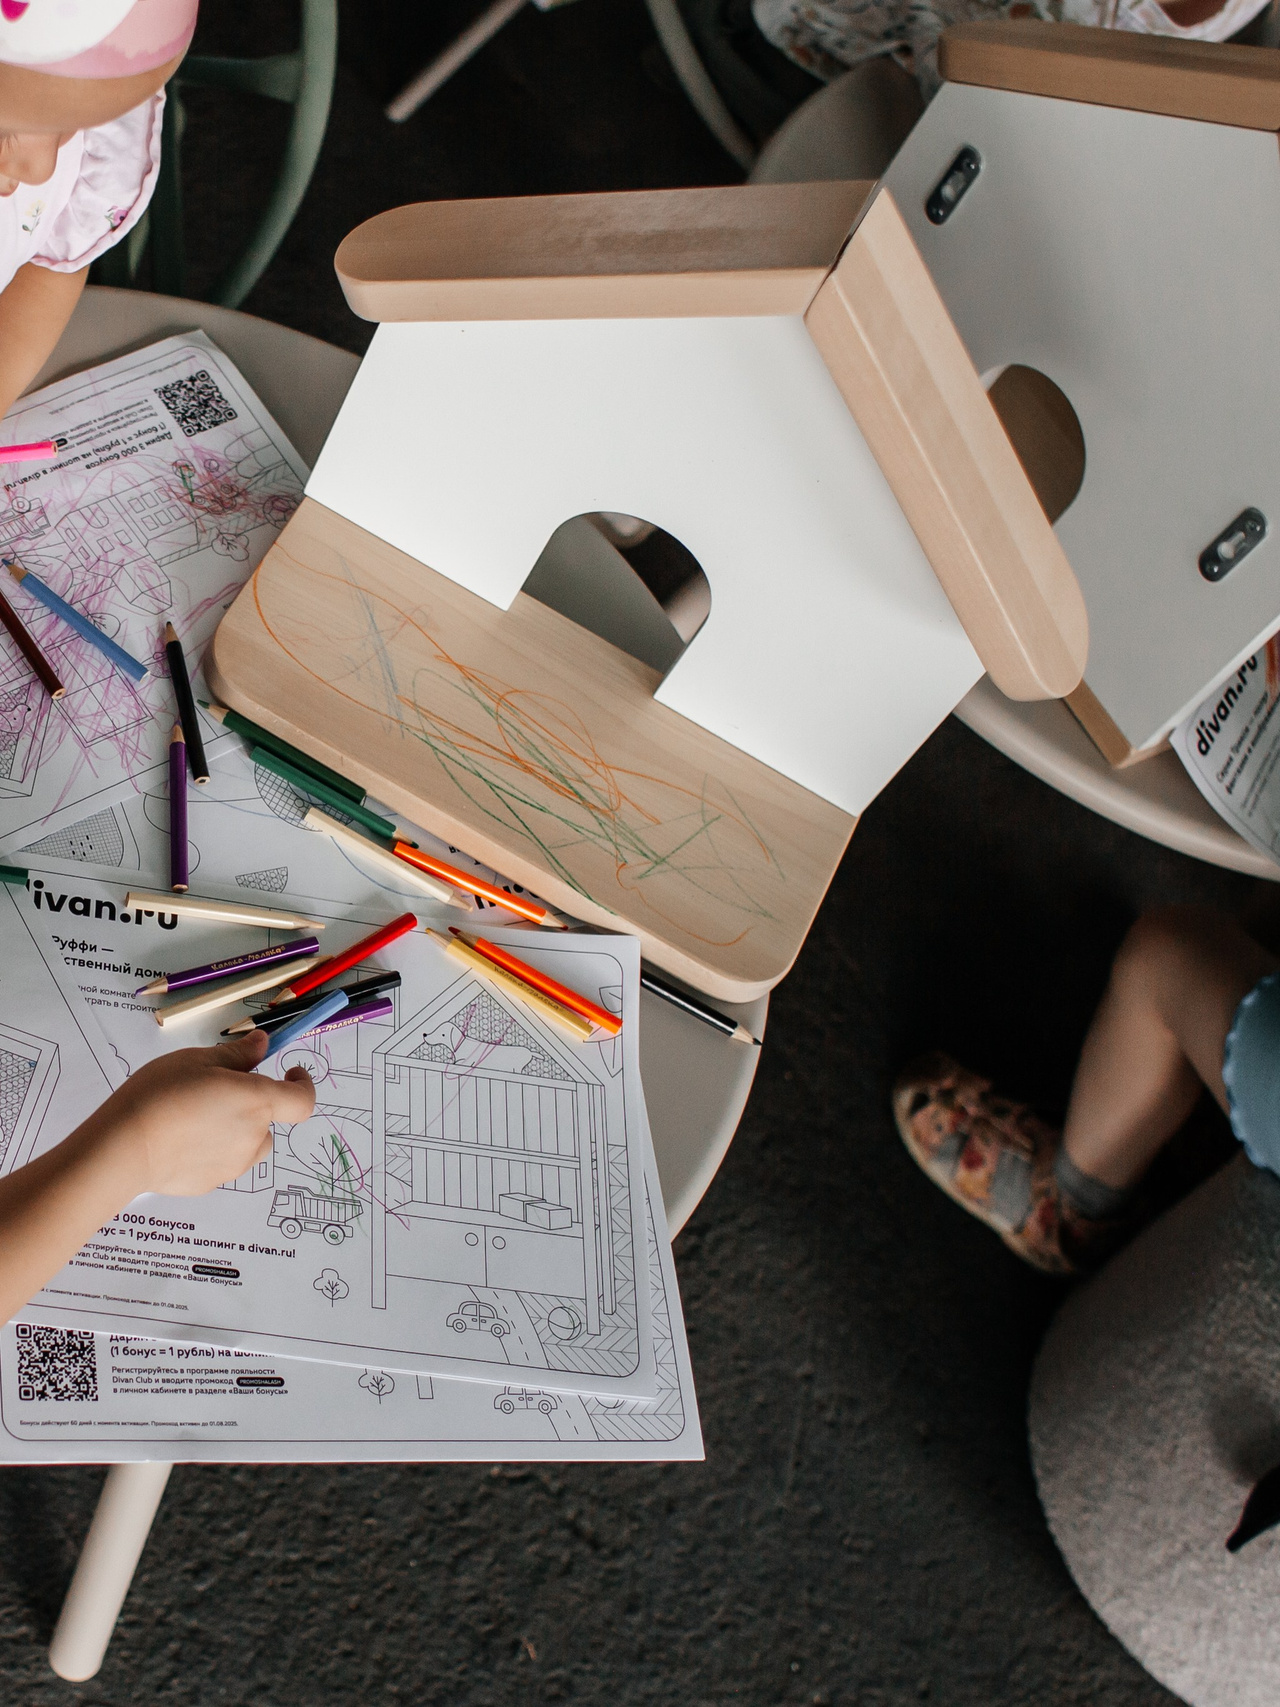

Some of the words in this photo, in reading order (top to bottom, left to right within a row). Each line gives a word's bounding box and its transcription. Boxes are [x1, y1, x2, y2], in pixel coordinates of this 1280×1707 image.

[120, 437, 127, 445] 1
[132, 423, 158, 441] бонус
[80, 450, 91, 459] на
[91, 438, 121, 457] рубль)
[120, 444, 138, 457] 000
[137, 442, 144, 450] 3
[48, 454, 80, 473] шопинг
[84, 450, 120, 472] бонусов
[3, 470, 41, 492] divan.ru!
[1197, 654, 1258, 757] divan.ru
[25, 879, 179, 930] ivan.ru
[59, 952, 131, 974] ственный
[77, 983, 97, 994] ной
[99, 987, 136, 999] комнате
[83, 996, 112, 1007] грать
[120, 1002, 160, 1015] строите
[122, 1213, 146, 1225] 000
[147, 1216, 195, 1232] бонусов
[96, 1225, 116, 1238] нус
[128, 1228, 133, 1237] 1
[136, 1229, 174, 1244] рубль)
[177, 1235, 190, 1244] на
[193, 1237, 236, 1250] шопинг
[247, 1243, 296, 1258] divan.ru!
[75, 1250, 90, 1258] van
[92, 1251, 109, 1261] Club
[117, 1255, 149, 1266] вводите
[150, 1260, 189, 1271] промокод
[83, 1241, 135, 1255] истрируйтесь
[143, 1249, 185, 1261] программе
[187, 1254, 232, 1266] лояльности
[74, 1259, 104, 1269] личном
[105, 1263, 141, 1274] кабинете
[149, 1269, 181, 1280] разделе
[183, 1272, 208, 1282] «Ваши
[209, 1275, 243, 1288] бонусы»
[110, 1345, 118, 1357] (1
[121, 1345, 156, 1358] бонус
[168, 1347, 173, 1356] 1
[177, 1346, 214, 1359] рубль)
[217, 1348, 231, 1356] на
[111, 1365, 178, 1375] Регистрируйтесь
[186, 1367, 228, 1375] программе
[230, 1367, 275, 1375] лояльности
[112, 1375, 133, 1383] Divan
[135, 1376, 152, 1384] Club
[161, 1377, 193, 1385] вводите
[195, 1377, 233, 1386] промокод
[150, 1386, 186, 1394] кабинете
[195, 1387, 226, 1396] разделе
[228, 1387, 254, 1395] «Ваши
[256, 1388, 288, 1396] бонусы»
